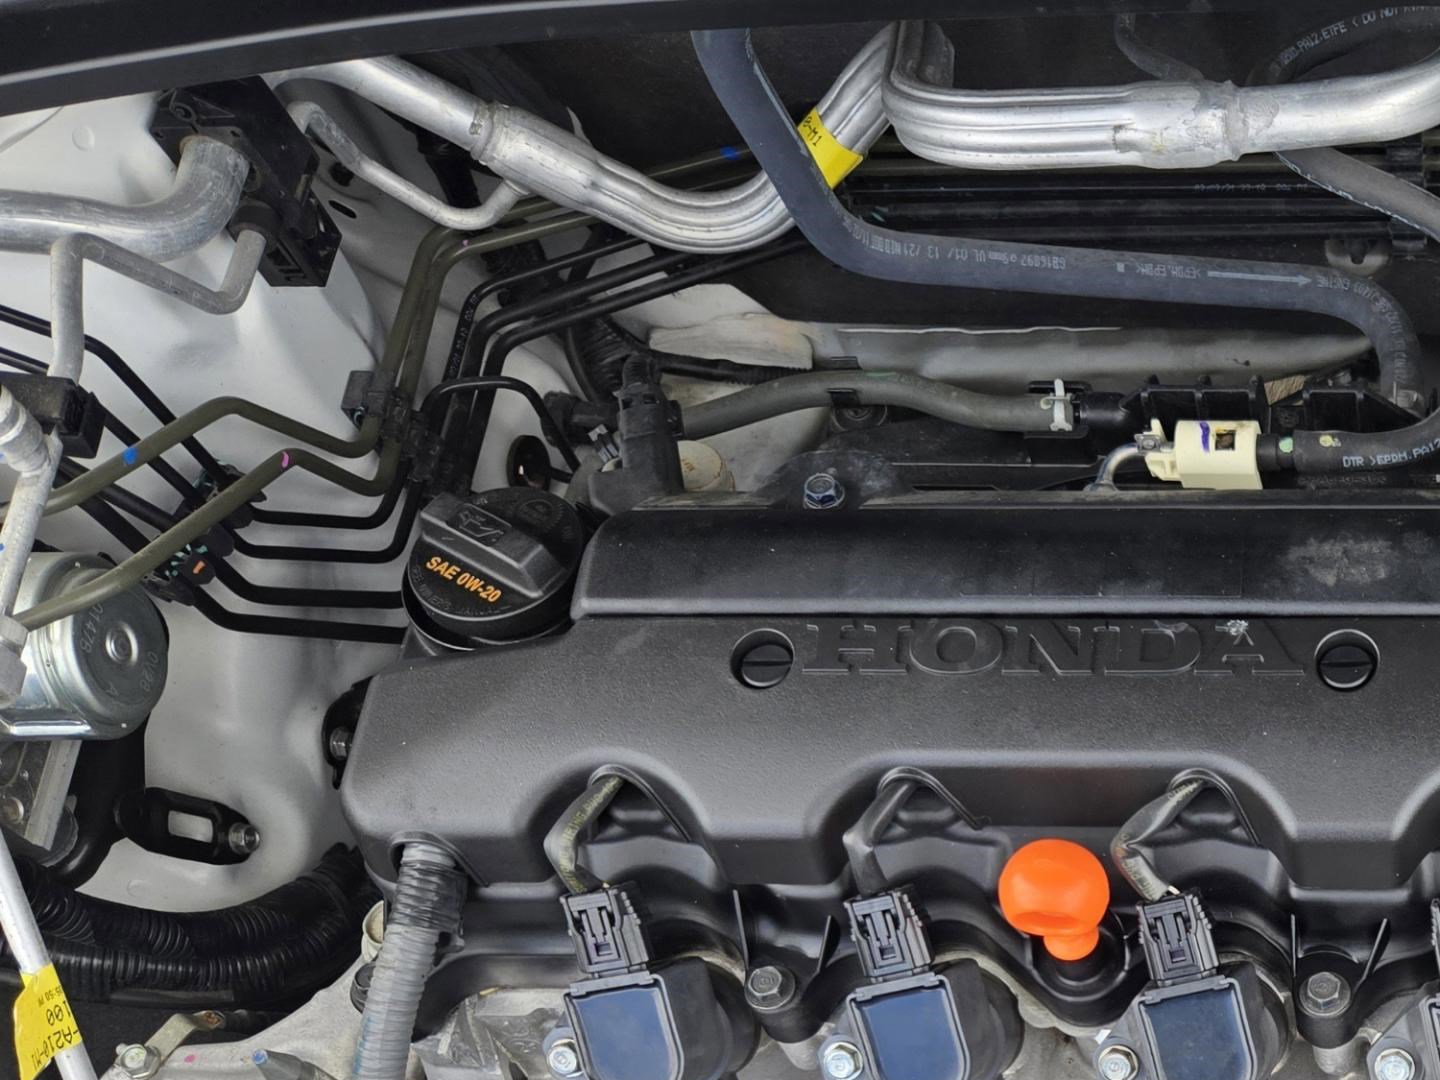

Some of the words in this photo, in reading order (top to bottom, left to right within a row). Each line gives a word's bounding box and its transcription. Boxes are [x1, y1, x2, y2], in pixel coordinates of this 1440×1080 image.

[1342, 455, 1365, 468] DTR
[425, 556, 461, 580] SAE
[456, 572, 503, 602] 0W-20
[801, 619, 1306, 676] HONDA
